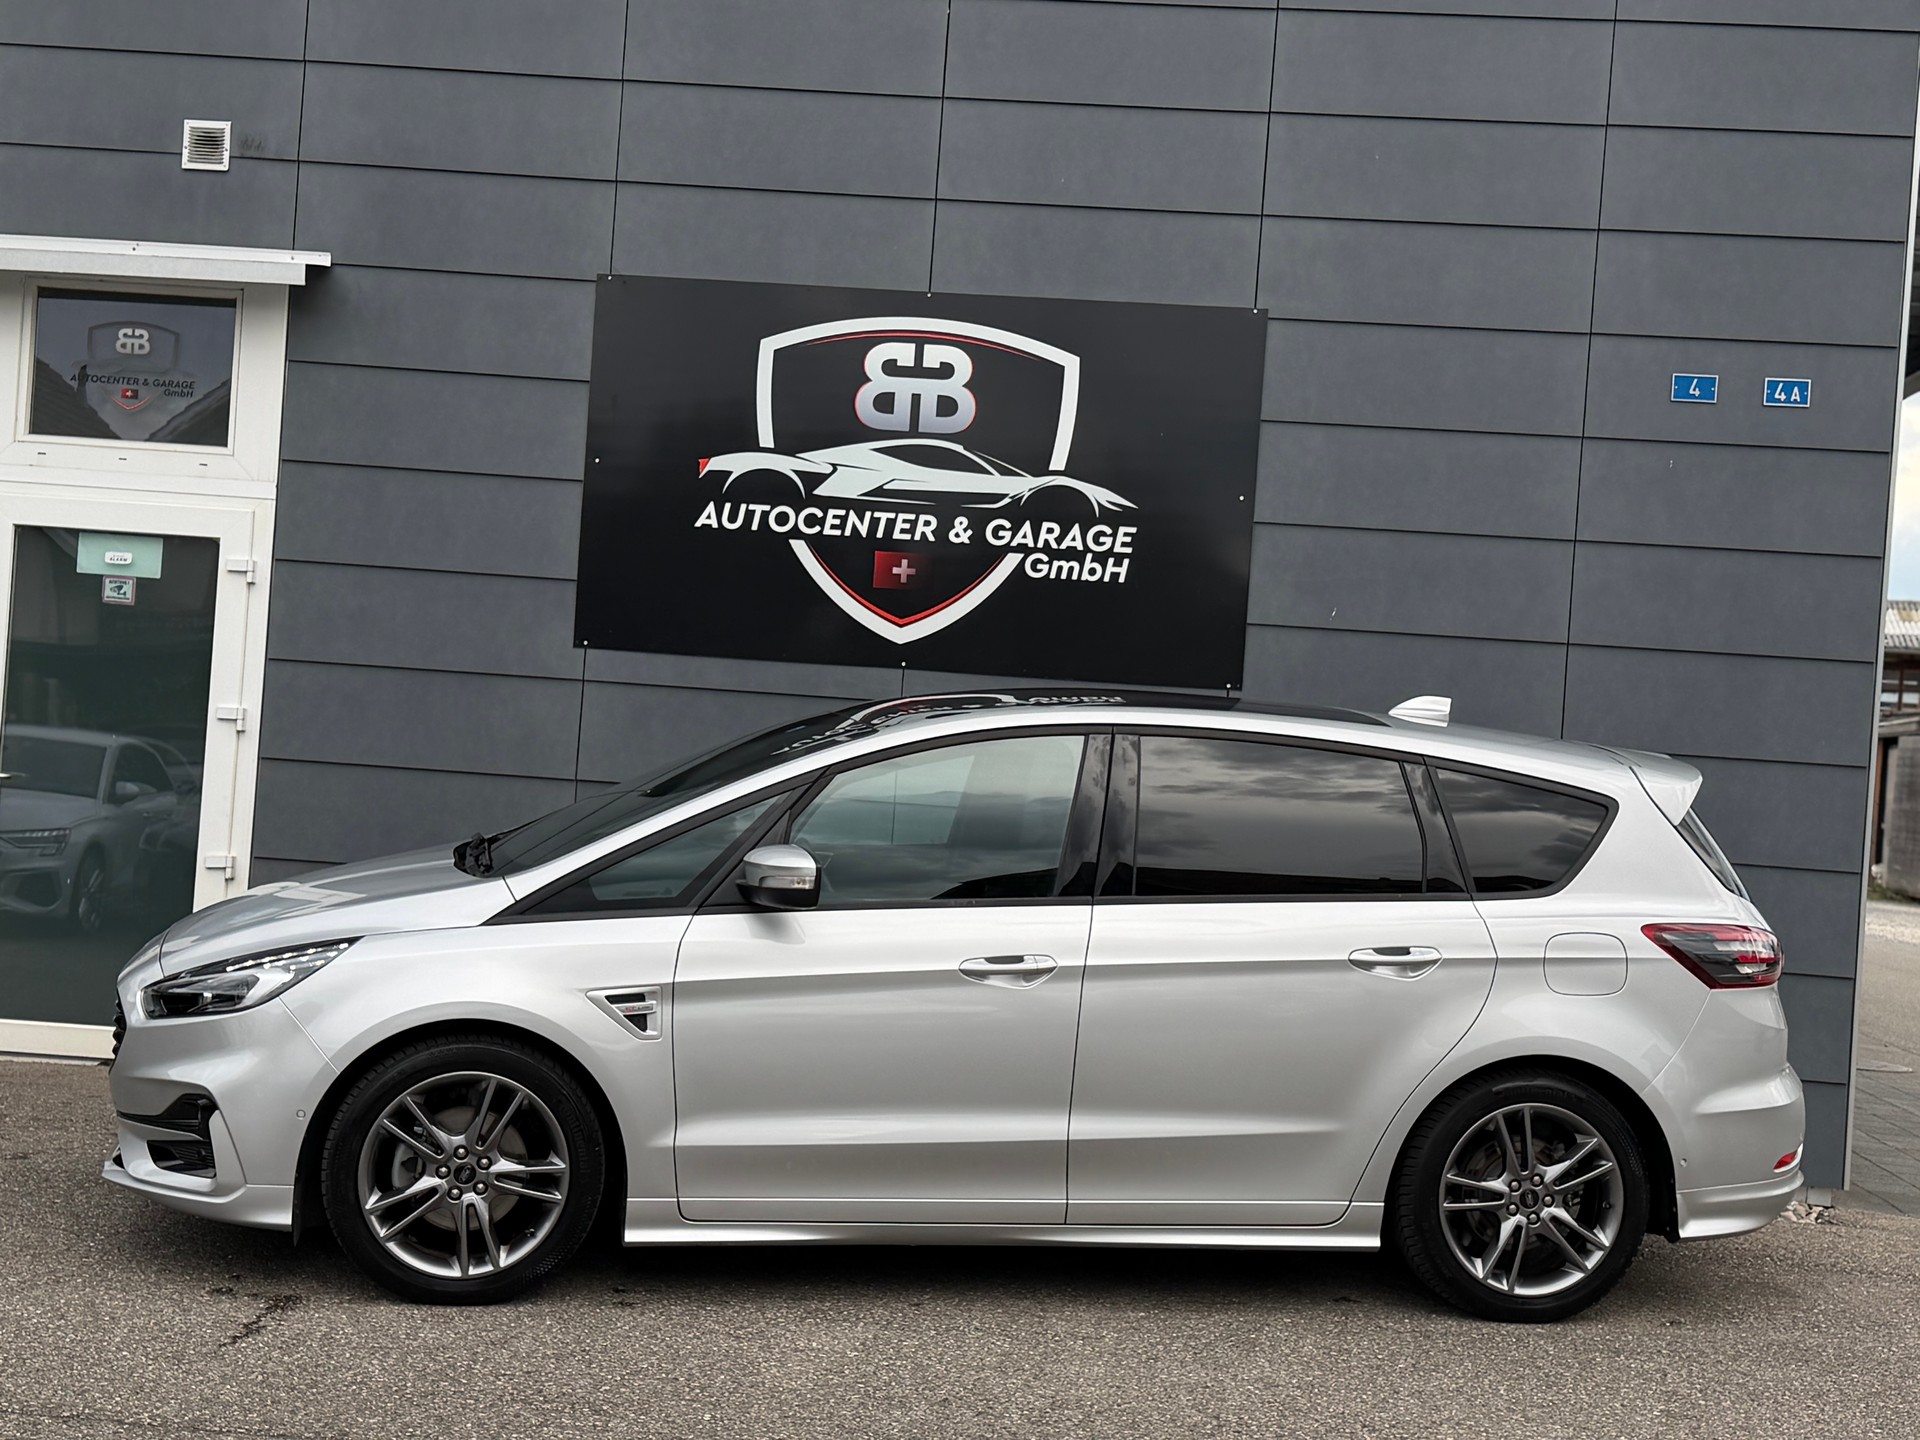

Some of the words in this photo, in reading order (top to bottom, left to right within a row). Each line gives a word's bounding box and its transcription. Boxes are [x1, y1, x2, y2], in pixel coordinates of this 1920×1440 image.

[142, 378, 150, 387] &
[153, 378, 196, 390] GARAGE
[163, 389, 194, 398] GmbH
[1688, 378, 1701, 397] 4
[694, 500, 938, 542] AUTOCENTER
[948, 516, 973, 544] &
[985, 518, 1138, 553] GARAGE
[1024, 552, 1130, 583] GmbH
